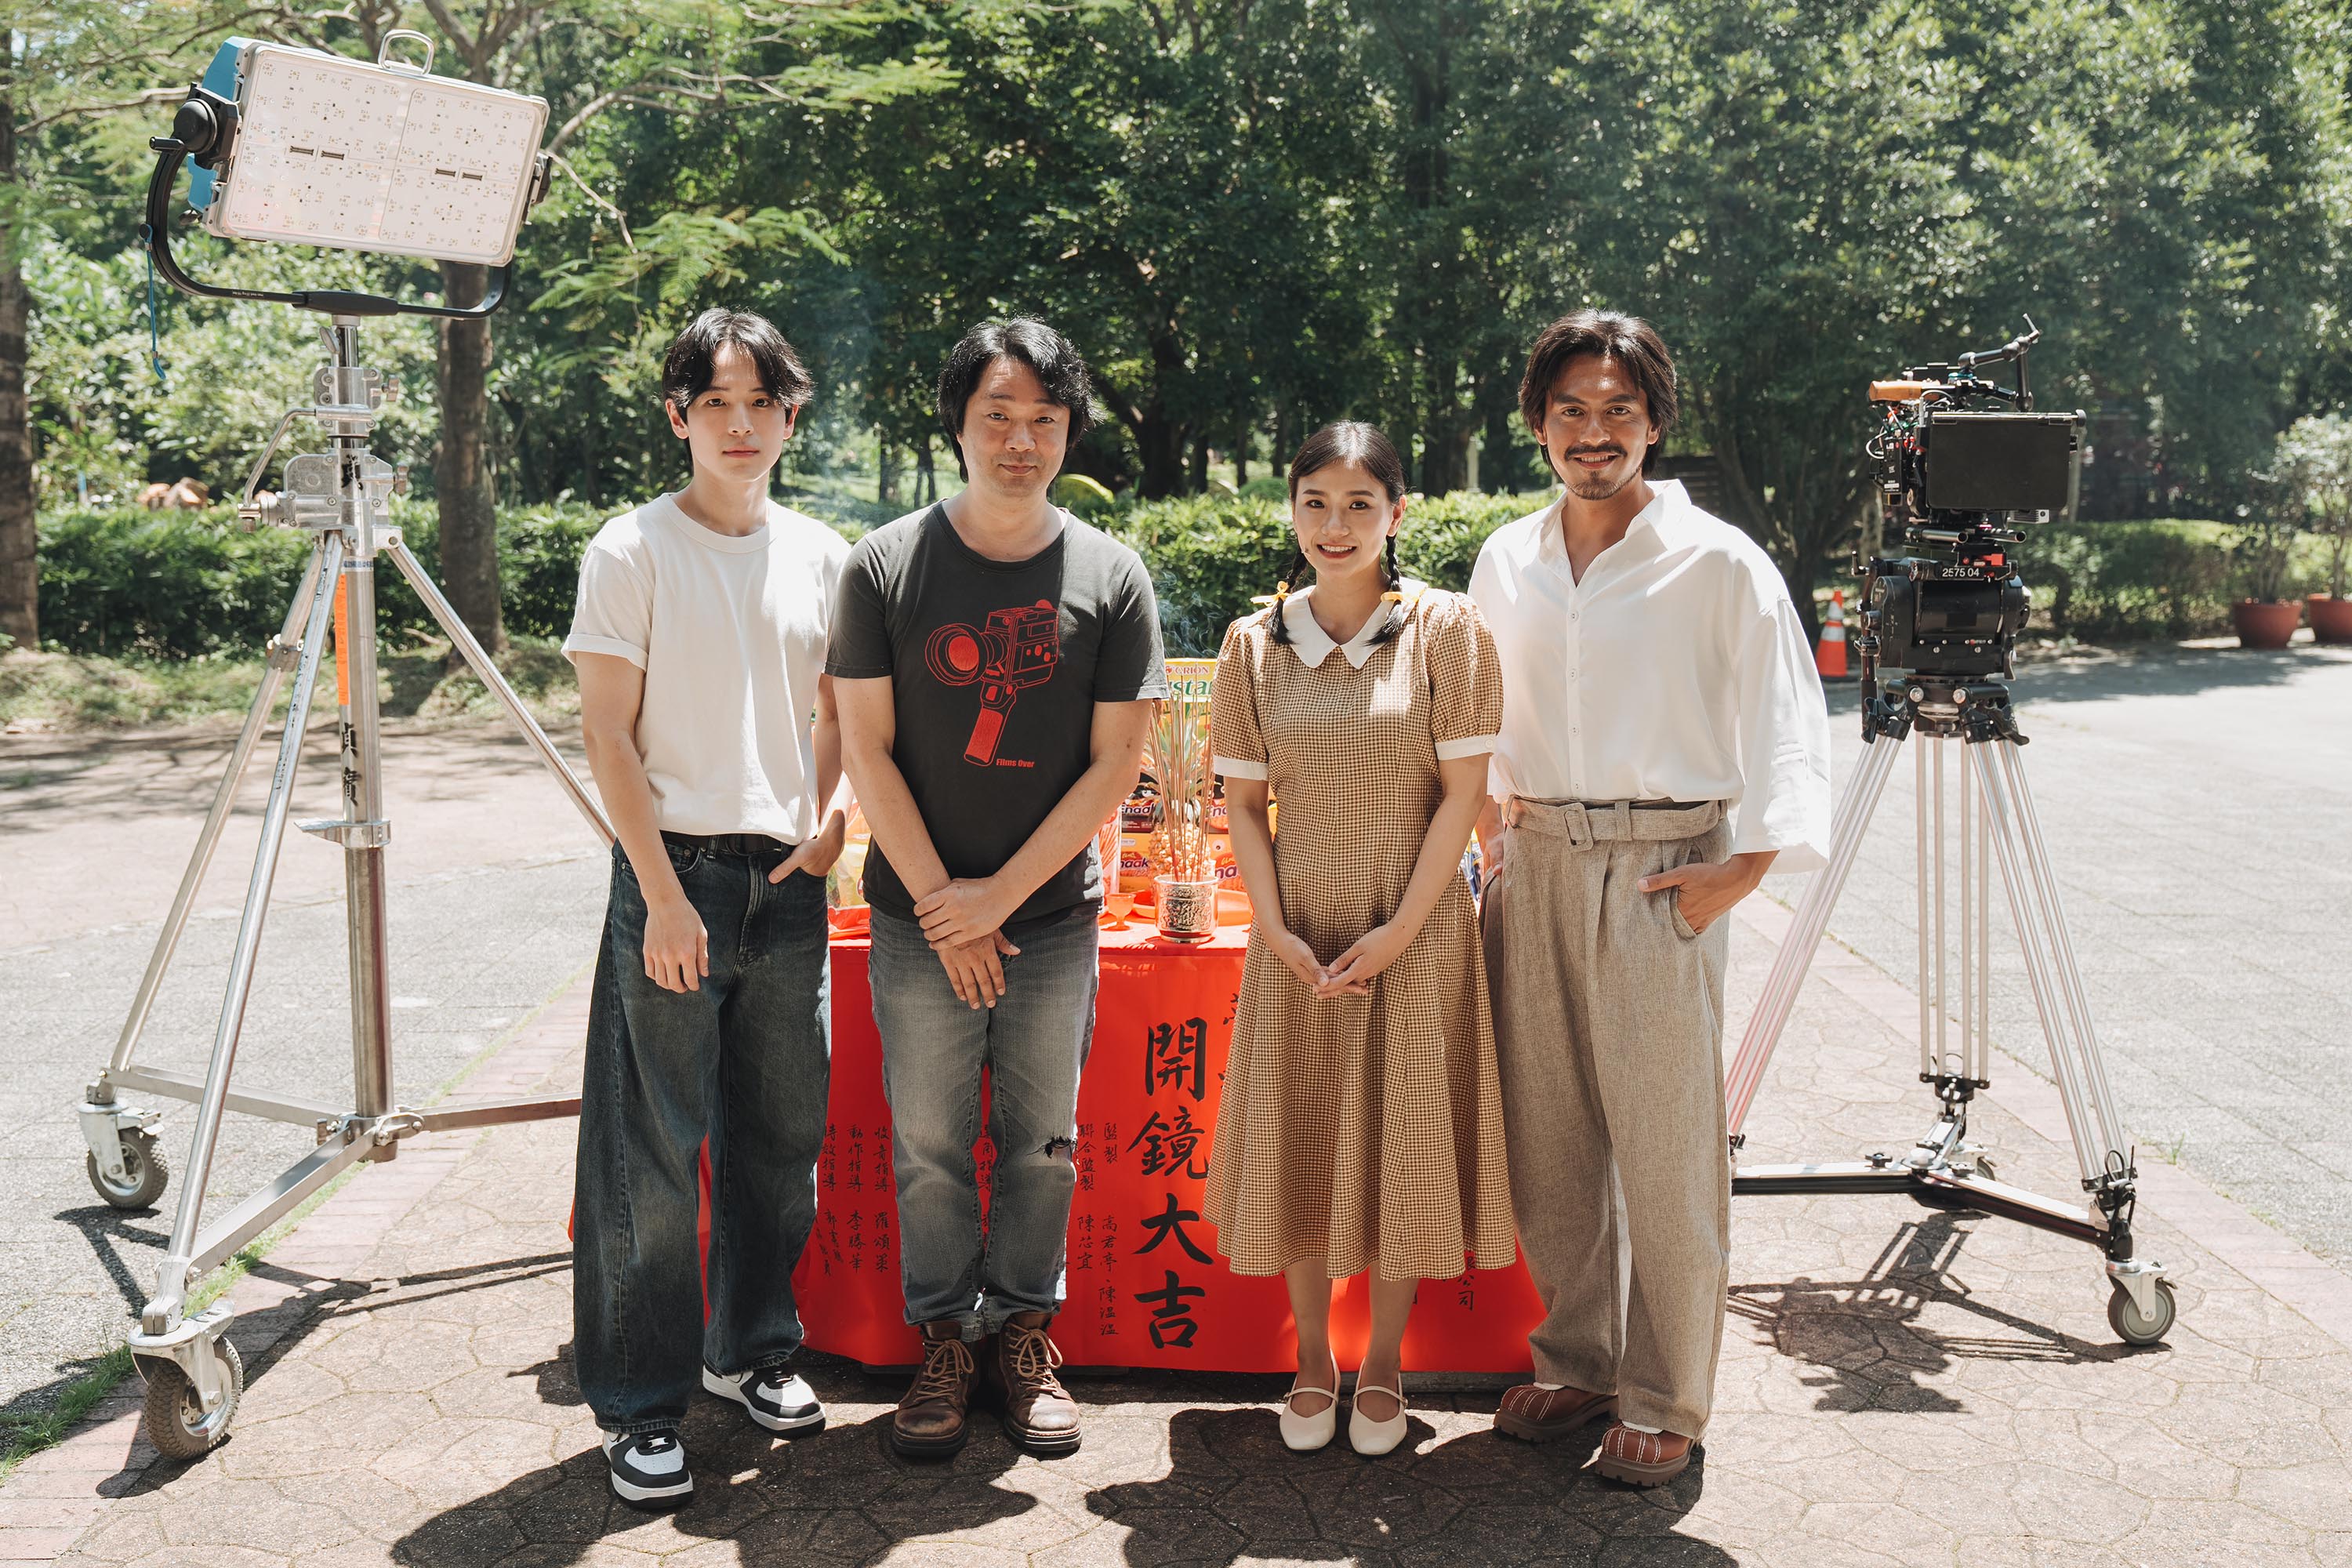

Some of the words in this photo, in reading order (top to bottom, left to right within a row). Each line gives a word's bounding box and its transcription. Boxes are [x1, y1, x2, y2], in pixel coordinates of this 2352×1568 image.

[1942, 568, 1965, 577] 2575
[1967, 568, 1980, 577] 04
[996, 758, 1017, 767] Films
[1018, 759, 1035, 768] Over
[846, 1123, 864, 1192] 動作指導
[1126, 1017, 1214, 1348] 開鏡大吉
